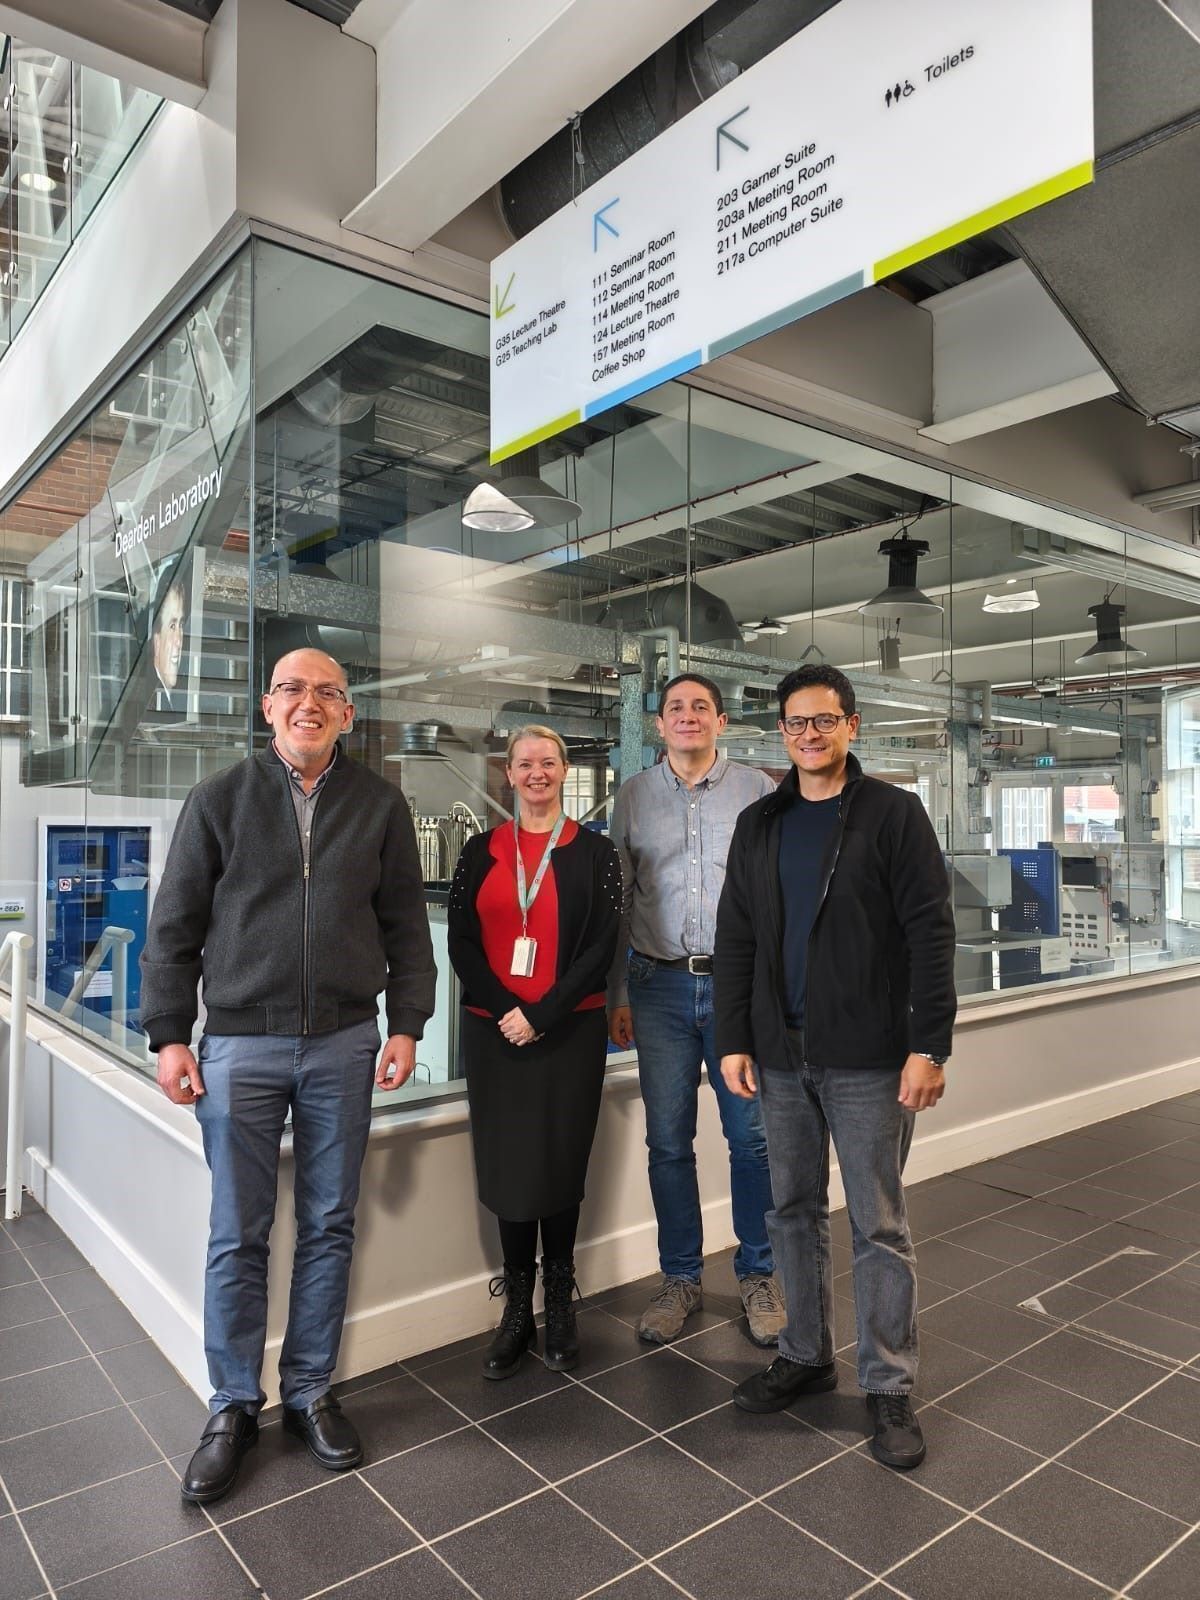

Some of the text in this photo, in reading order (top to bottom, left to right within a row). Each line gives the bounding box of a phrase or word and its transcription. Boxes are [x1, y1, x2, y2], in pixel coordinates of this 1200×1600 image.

[923, 45, 975, 82] Toilets
[716, 142, 816, 211] 203 Garner Suite
[716, 154, 835, 232] 203a Meeting Room
[716, 183, 828, 254] 211 Meeting Room
[716, 197, 843, 275] 217a Computer Suite
[593, 231, 675, 288] 111 Seminar Room
[593, 251, 675, 308] 112 Seminar Room
[495, 300, 566, 350] G35 Lecture Theatre
[593, 272, 675, 326] 114 Meeting Room
[593, 289, 680, 344] 124 Lecture Theatre
[495, 322, 557, 367] G25 Teaching Lab
[592, 348, 646, 382] Coffee Shop
[593, 312, 675, 363] 157 Meeting Room
[115, 466, 222, 558] Dearden Laboratory
